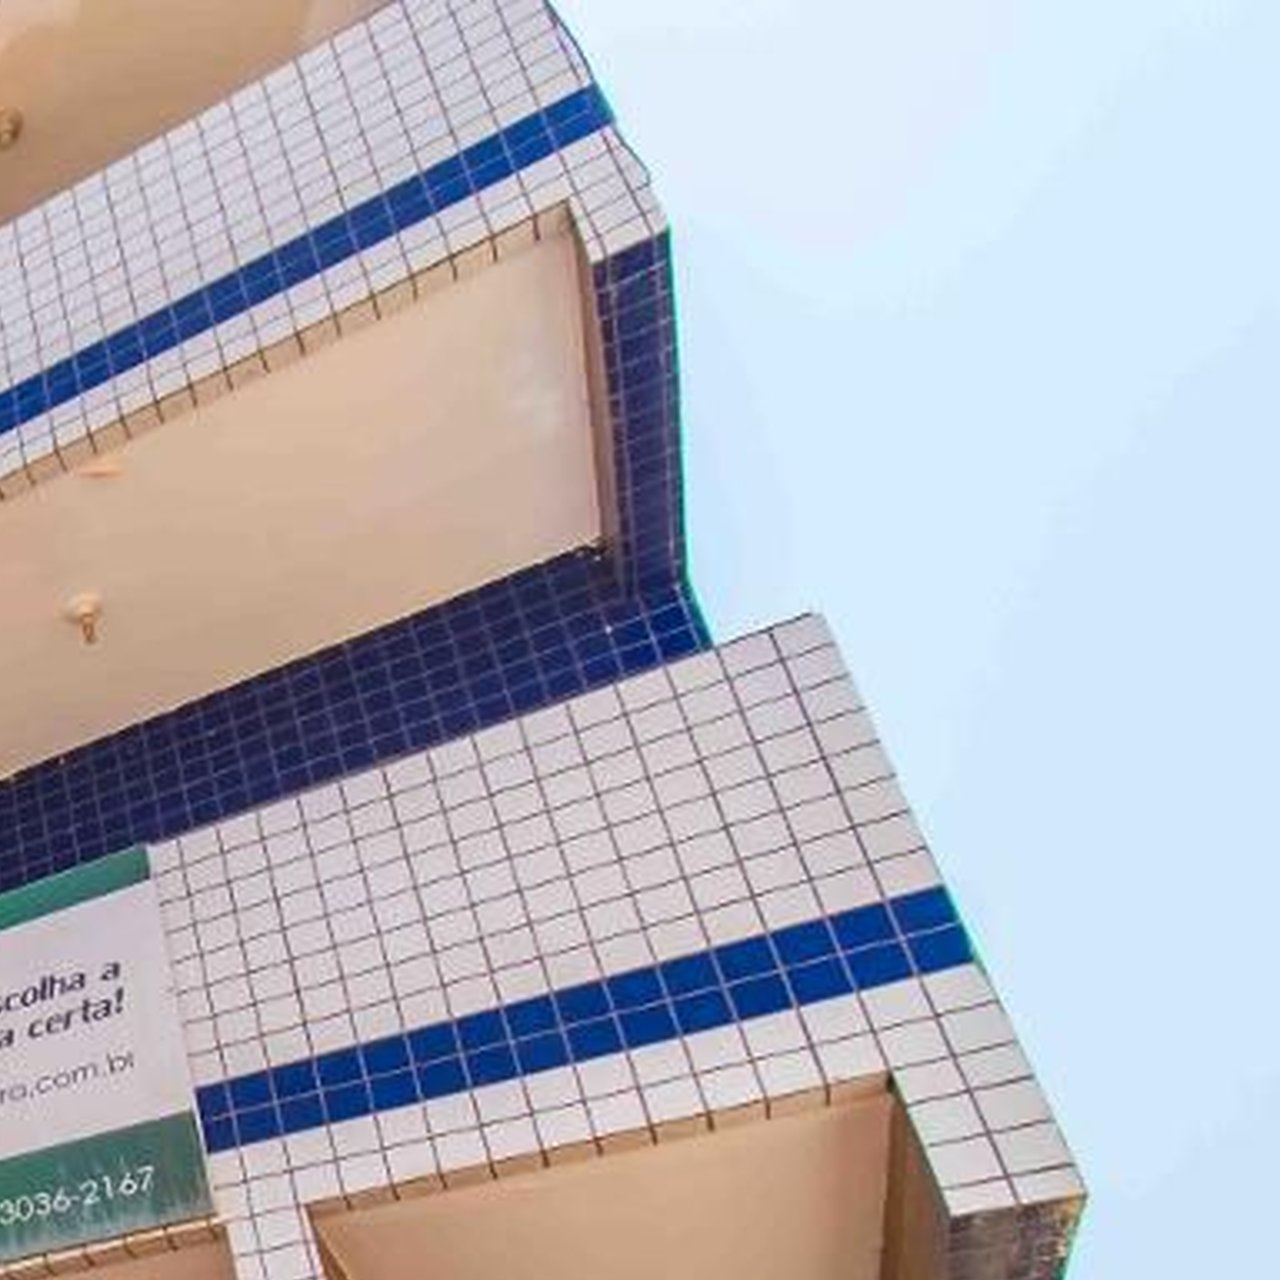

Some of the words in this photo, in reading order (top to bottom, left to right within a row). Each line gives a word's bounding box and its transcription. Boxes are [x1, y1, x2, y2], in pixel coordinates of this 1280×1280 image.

[100, 961, 121, 981] a
[28, 986, 124, 1039] certa!
[0, 1164, 154, 1226] 3036-2167
